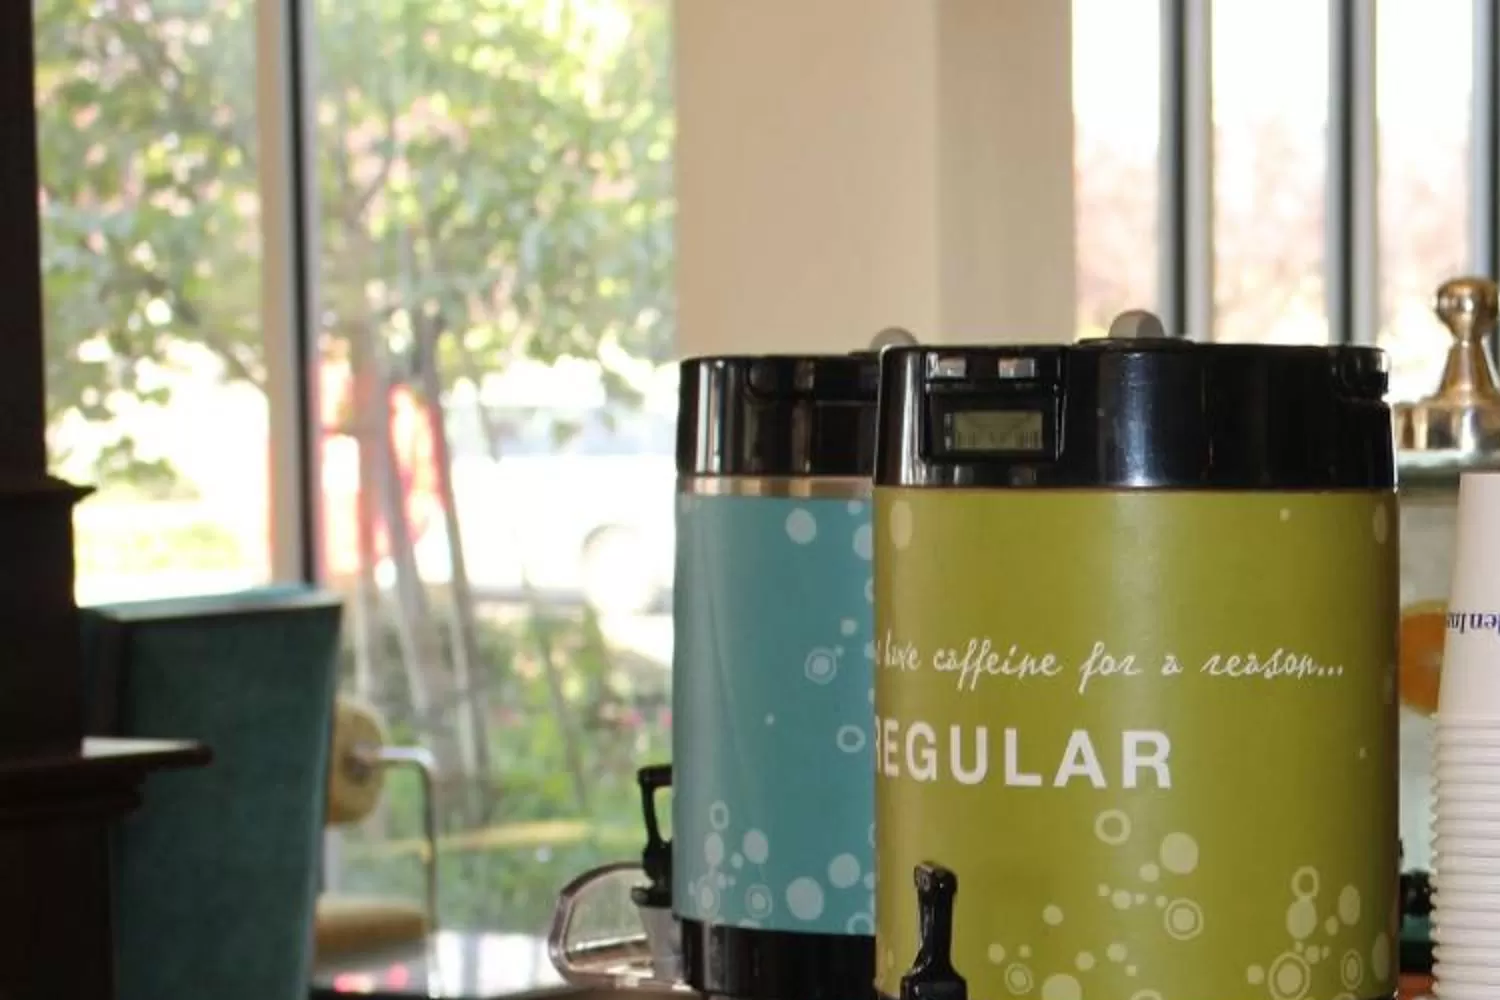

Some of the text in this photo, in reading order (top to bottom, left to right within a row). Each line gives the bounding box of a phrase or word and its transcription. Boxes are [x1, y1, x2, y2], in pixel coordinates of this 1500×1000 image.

[933, 636, 1063, 691] caffeine
[1078, 640, 1142, 695] for
[1161, 654, 1184, 677] a
[1199, 647, 1344, 680] reason...
[874, 714, 1172, 790] EGULAR
